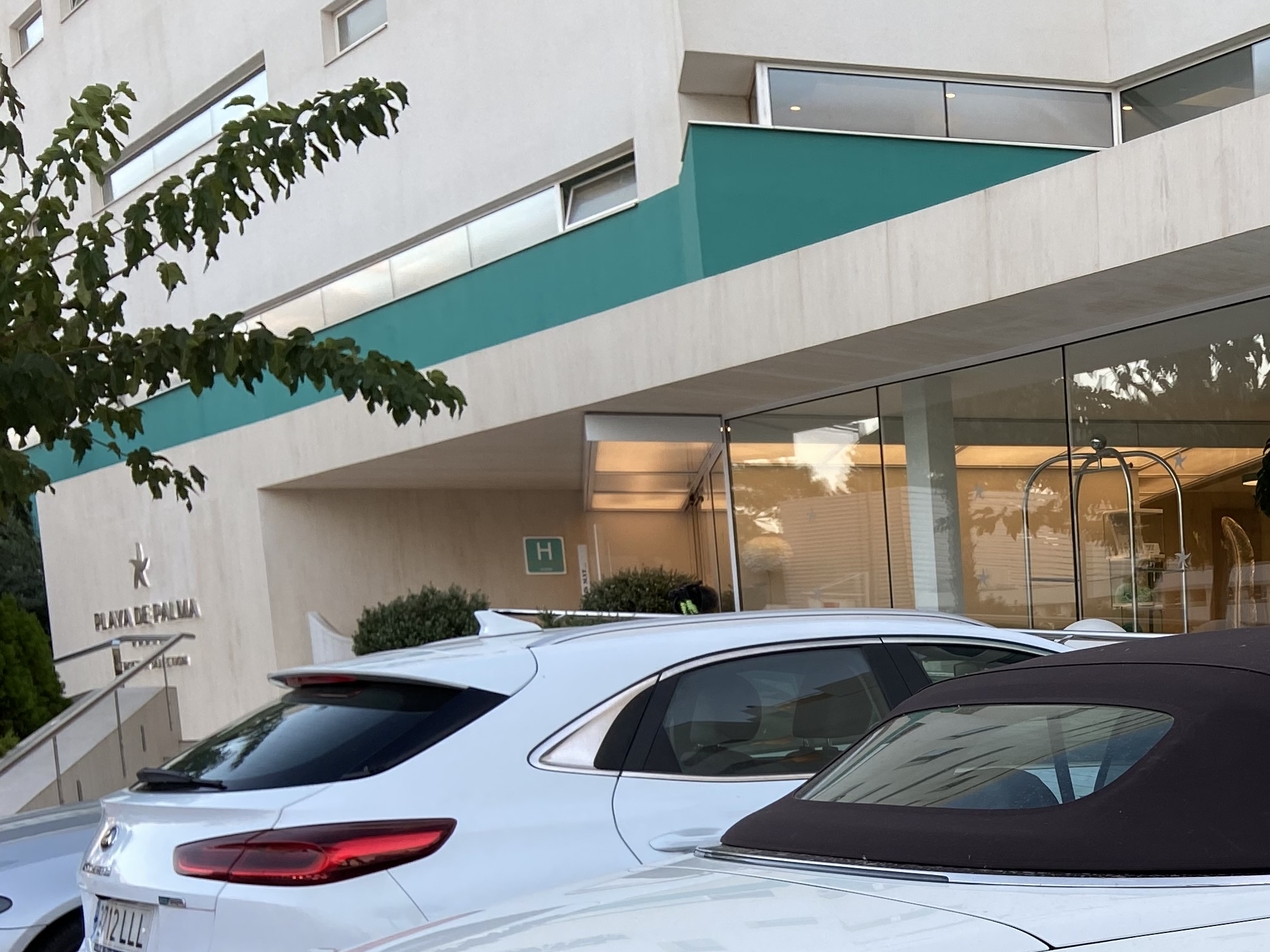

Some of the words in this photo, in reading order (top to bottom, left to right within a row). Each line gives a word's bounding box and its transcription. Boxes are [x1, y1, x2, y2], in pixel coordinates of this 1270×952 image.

[94, 609, 135, 631] PLAYA
[135, 605, 153, 626] DE
[153, 598, 202, 623] PALMA
